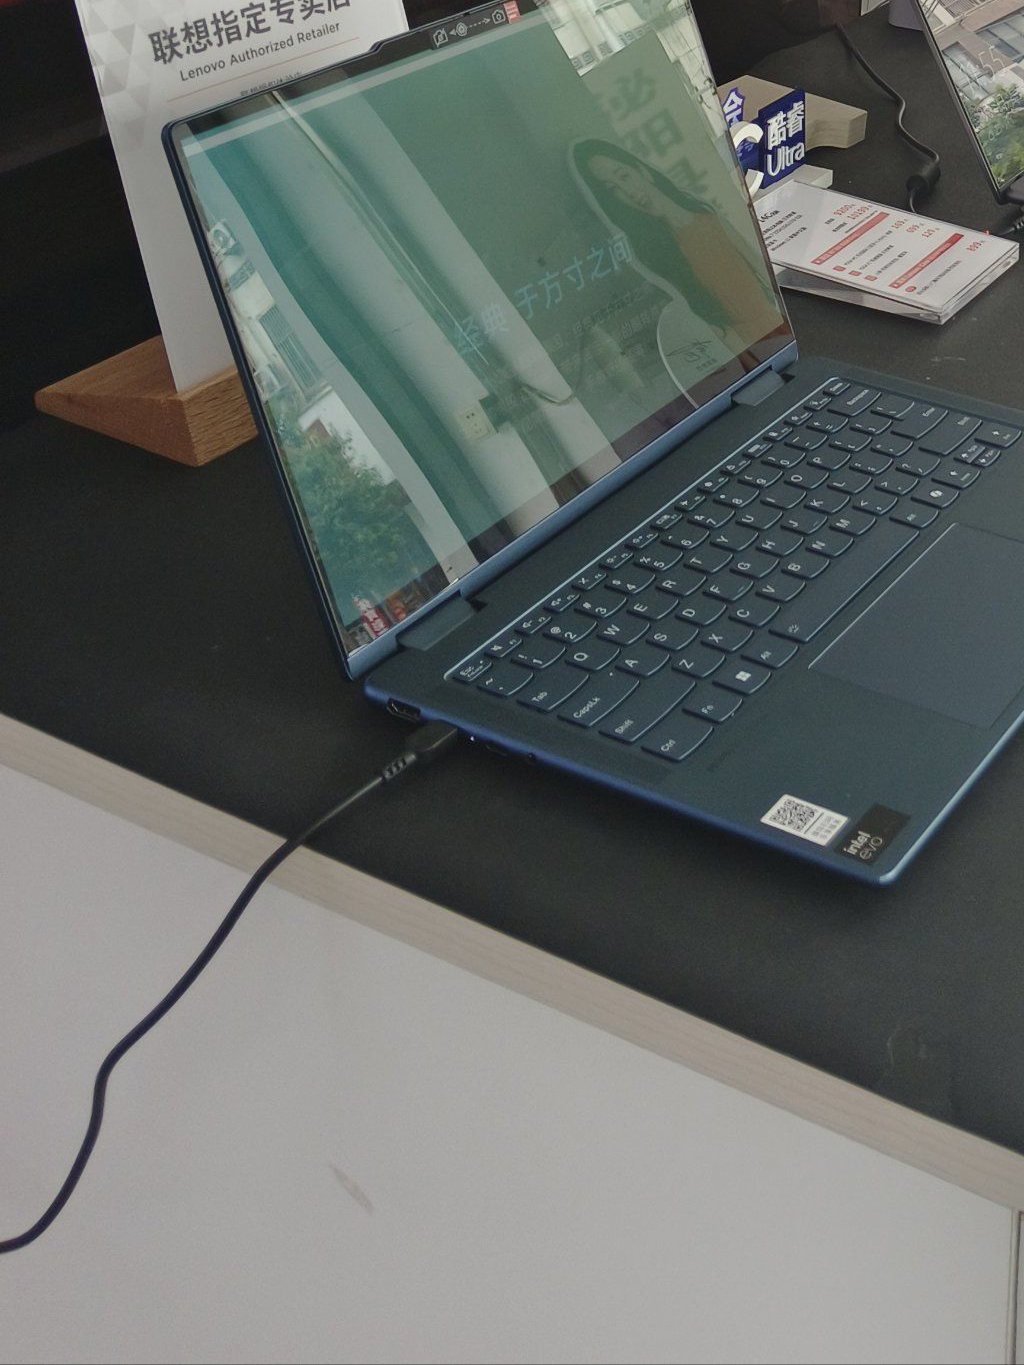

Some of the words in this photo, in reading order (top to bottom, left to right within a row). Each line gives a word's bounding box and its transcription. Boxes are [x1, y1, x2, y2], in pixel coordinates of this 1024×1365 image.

[180, 60, 226, 82] Lenovo
[230, 36, 295, 66] Authorized
[298, 21, 340, 44] Retailer
[767, 101, 804, 151] 酷睿
[766, 142, 805, 177] Ultra
[843, 830, 871, 855] intel
